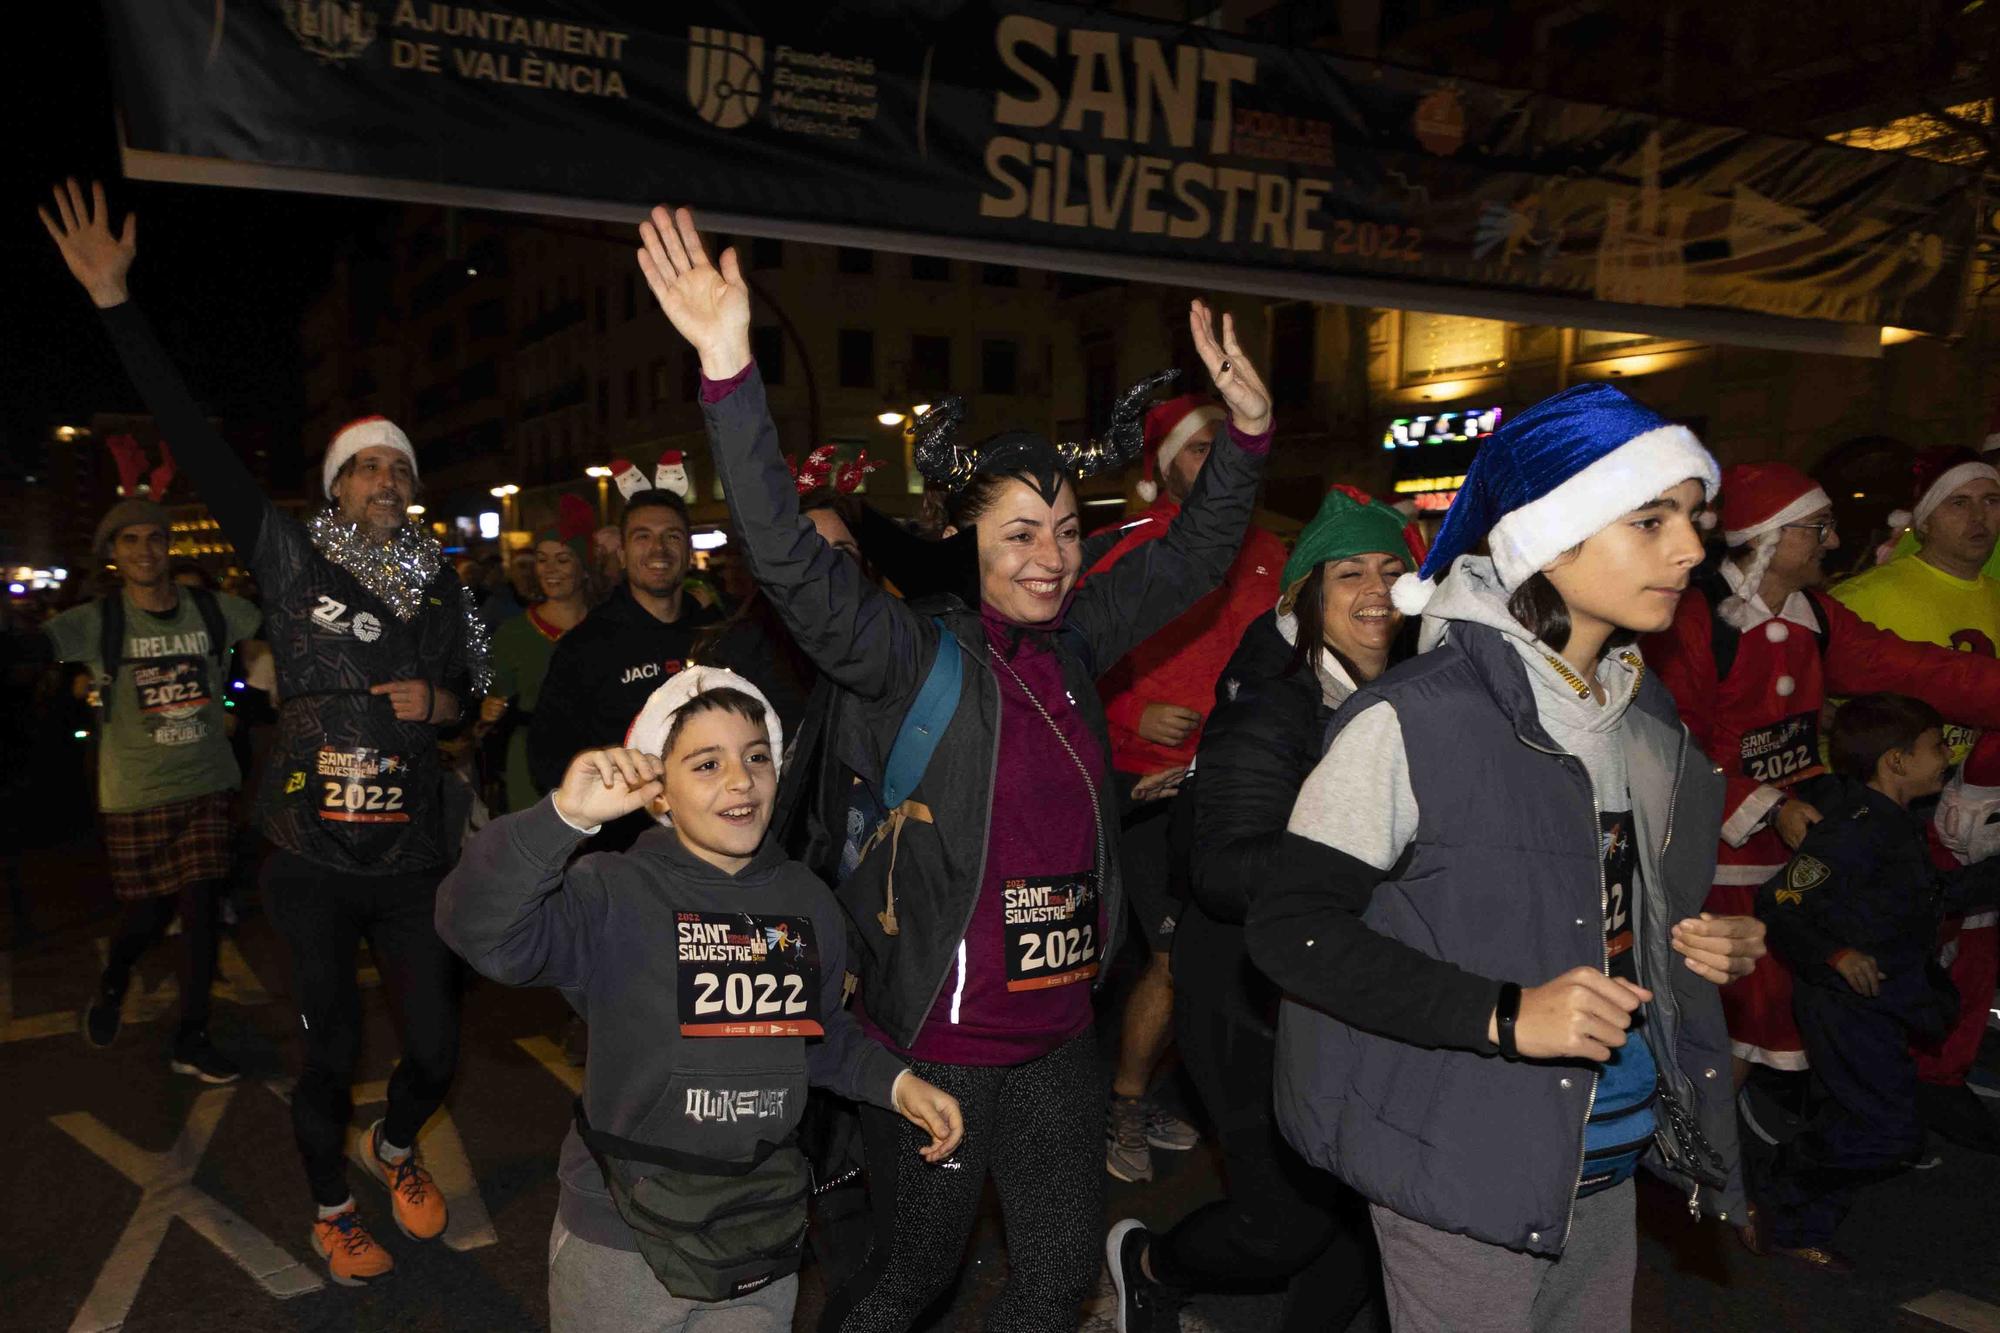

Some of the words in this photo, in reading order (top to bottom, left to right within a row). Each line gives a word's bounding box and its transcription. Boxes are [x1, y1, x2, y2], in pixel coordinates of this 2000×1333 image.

[391, 0, 630, 61] AJUNTAMENT
[391, 37, 442, 75] DE
[452, 48, 629, 100] VALÈNCIA
[994, 13, 1257, 154] SANT
[1333, 218, 1424, 263] 2022
[130, 631, 209, 658] IRELAND
[144, 681, 203, 706] 2022
[1741, 731, 1773, 748] SANT
[317, 750, 354, 766] SANT
[1751, 745, 1811, 782] 2022
[323, 782, 405, 811] 2022
[1004, 886, 1052, 908] SANT
[677, 922, 731, 944] SANT
[1019, 924, 1096, 972] 2022
[693, 972, 808, 1016] 2022
